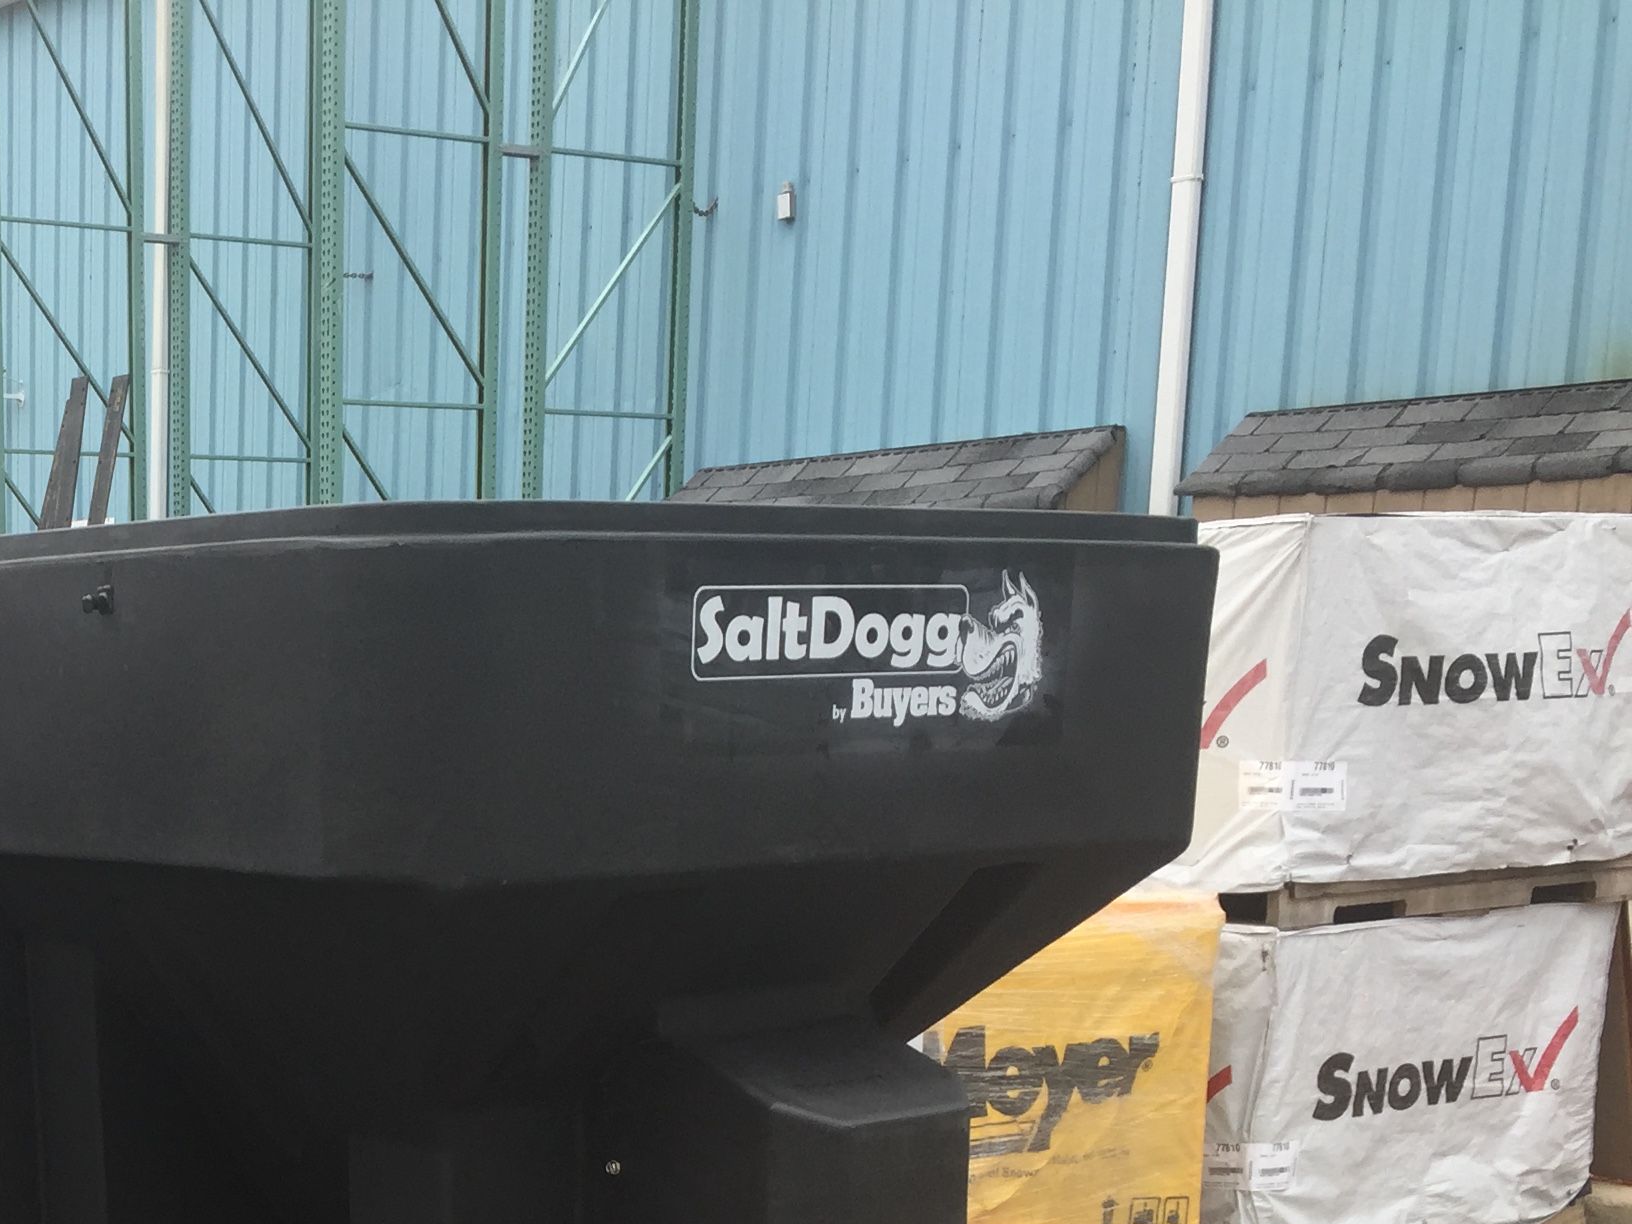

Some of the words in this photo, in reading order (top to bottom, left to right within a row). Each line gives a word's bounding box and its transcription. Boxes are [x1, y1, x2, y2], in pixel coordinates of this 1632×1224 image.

[697, 595, 963, 668] SaltDogg
[832, 704, 847, 722] by
[850, 679, 957, 727] Buyers
